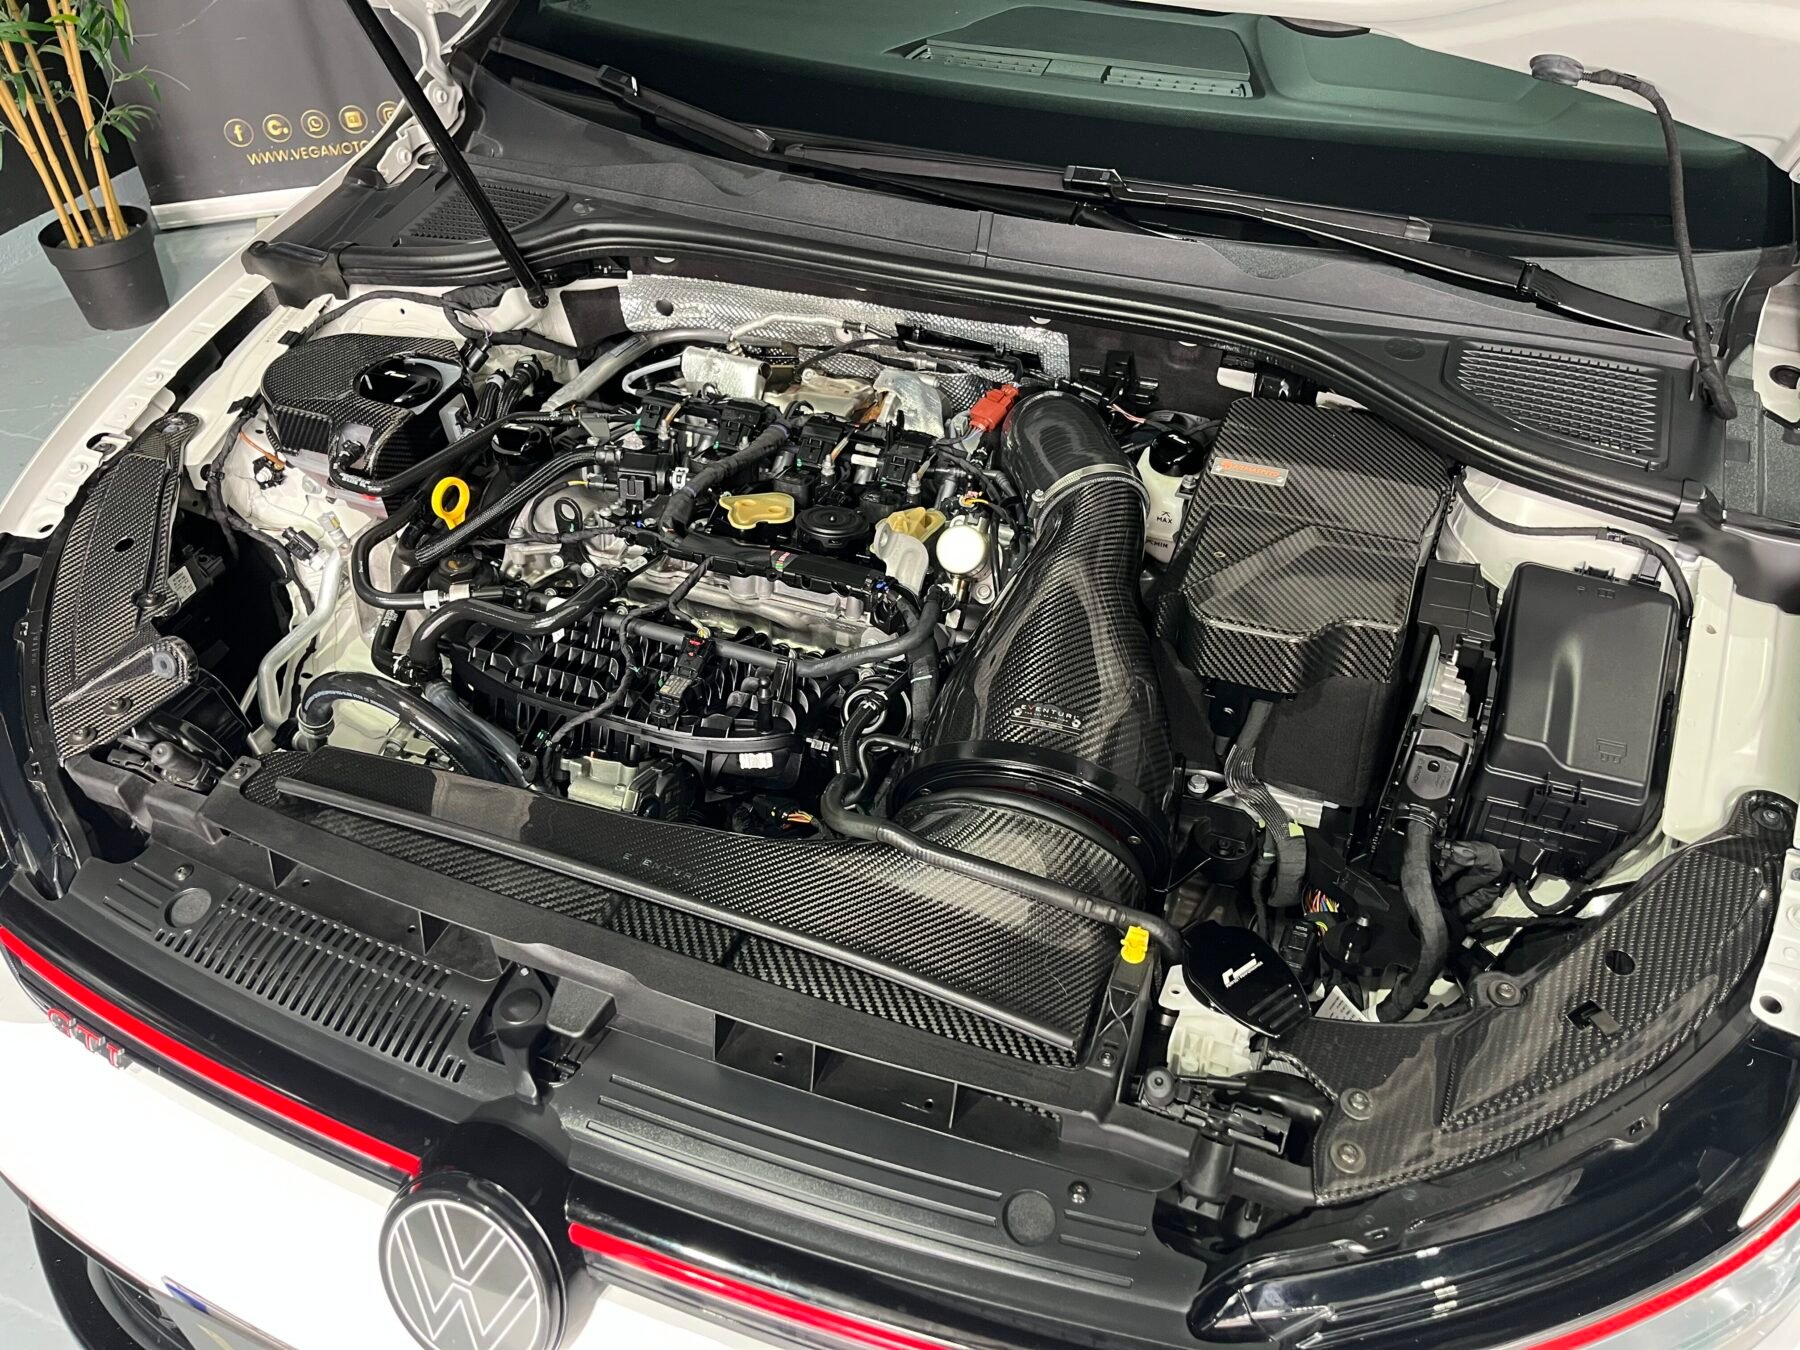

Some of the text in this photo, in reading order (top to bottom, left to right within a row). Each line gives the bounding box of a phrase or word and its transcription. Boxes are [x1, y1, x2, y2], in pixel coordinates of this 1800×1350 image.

[1156, 516, 1173, 524] MAX
[622, 852, 699, 883] EENTURI
[47, 1007, 126, 1071] GTI
